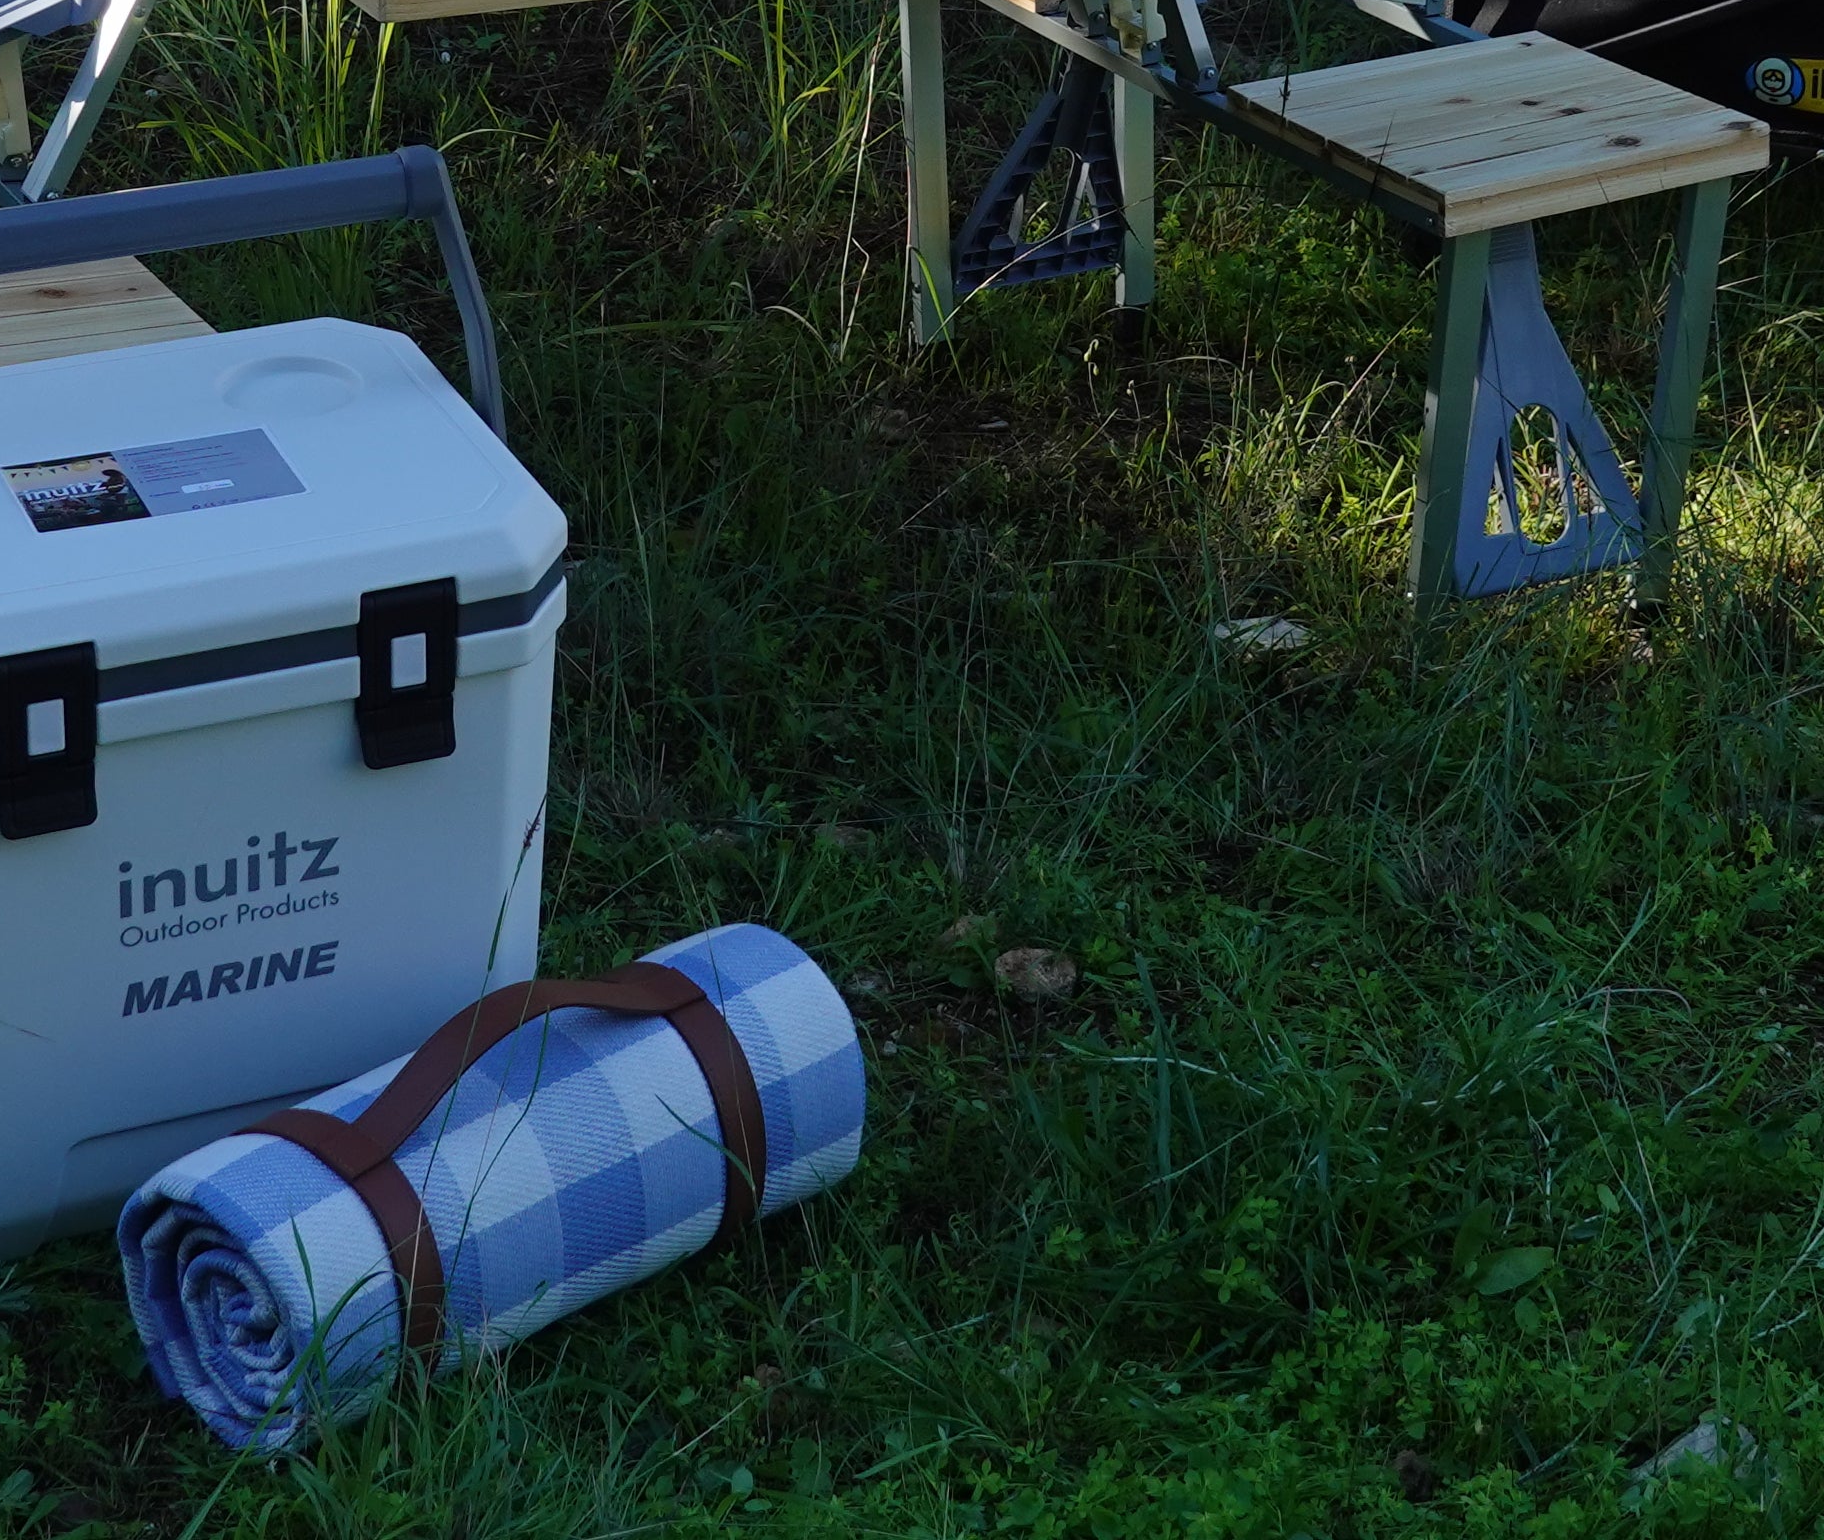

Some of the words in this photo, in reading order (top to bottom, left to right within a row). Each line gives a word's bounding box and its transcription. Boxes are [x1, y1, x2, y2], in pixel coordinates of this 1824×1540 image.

[119, 831, 340, 919] inuitz
[119, 913, 229, 948] Outdoor
[237, 889, 340, 925] Products
[121, 940, 340, 1018] MARINE
